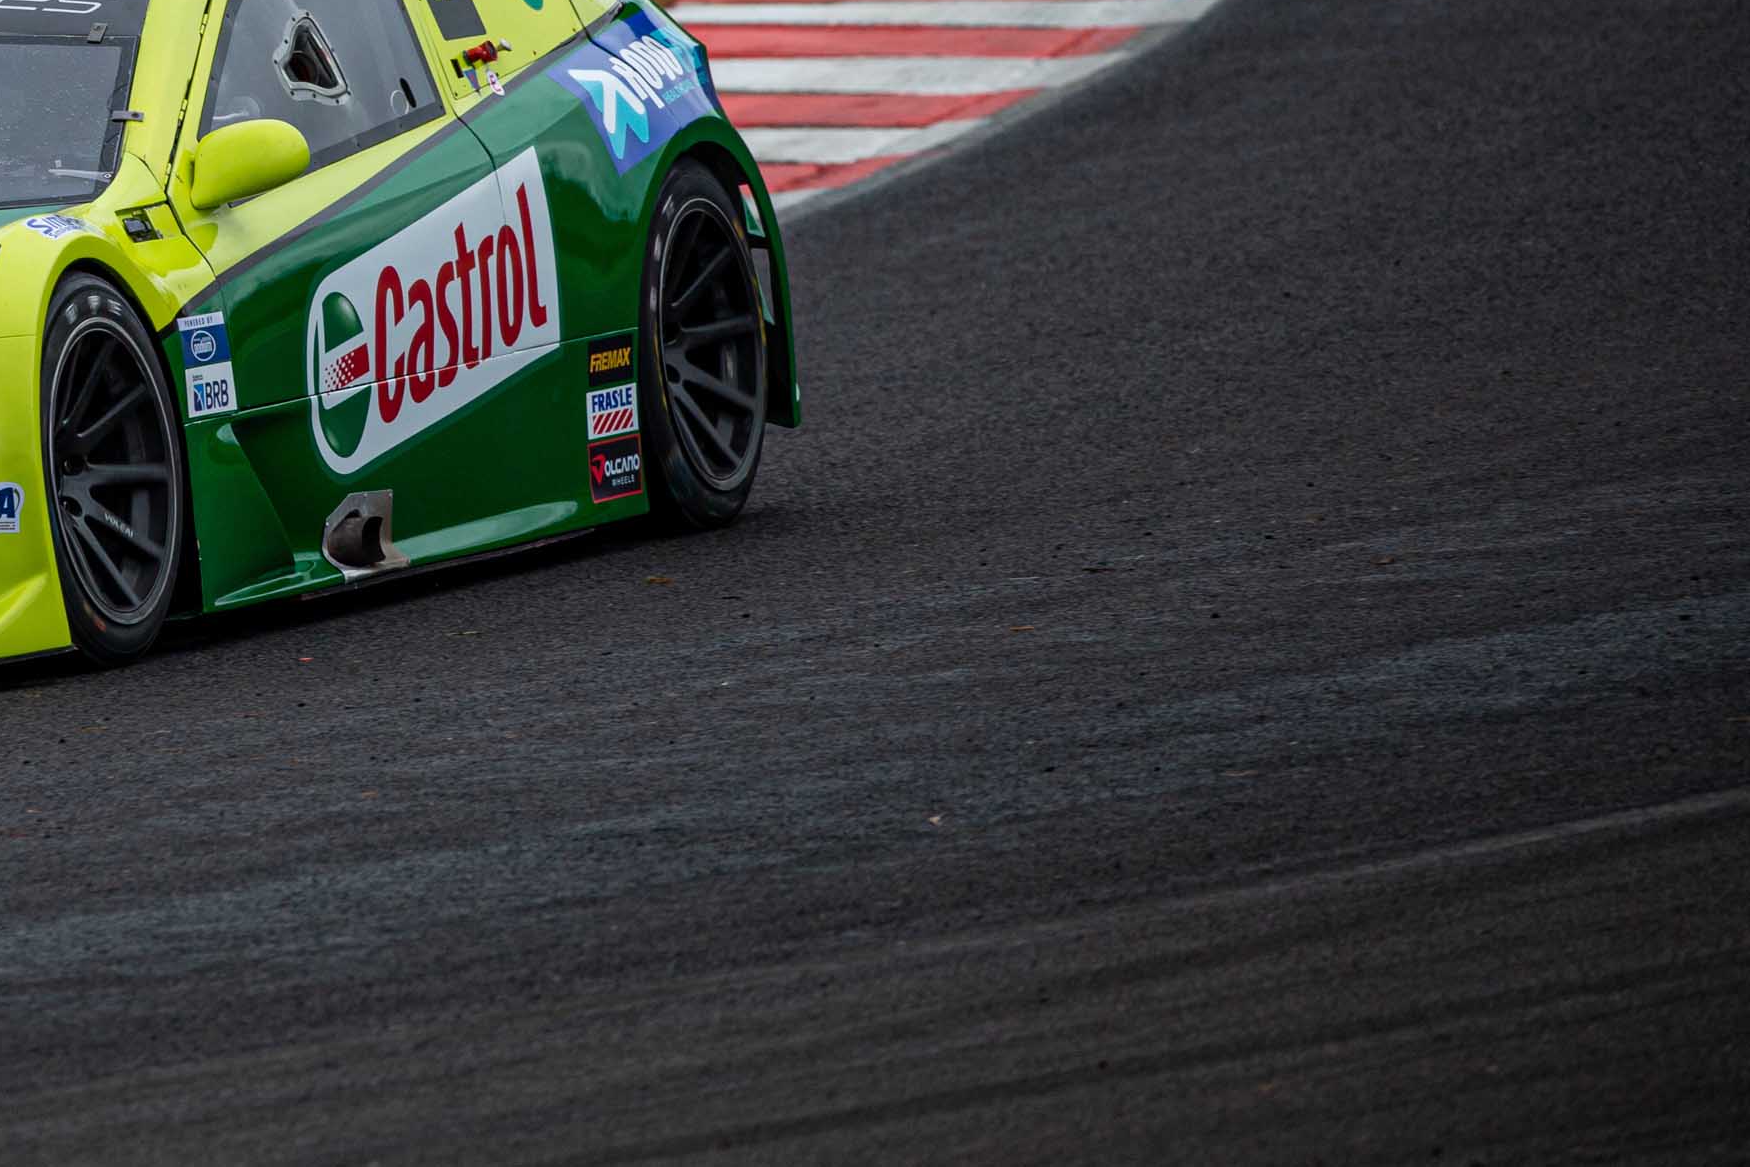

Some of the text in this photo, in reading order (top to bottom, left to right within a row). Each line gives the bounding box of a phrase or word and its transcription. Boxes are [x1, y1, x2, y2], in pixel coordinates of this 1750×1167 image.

[375, 182, 548, 424] Castrol
[590, 347, 631, 373] FREMAX
[205, 379, 229, 410] BRB
[591, 453, 640, 485] VOLCANO
[612, 474, 635, 487] WHEELS
